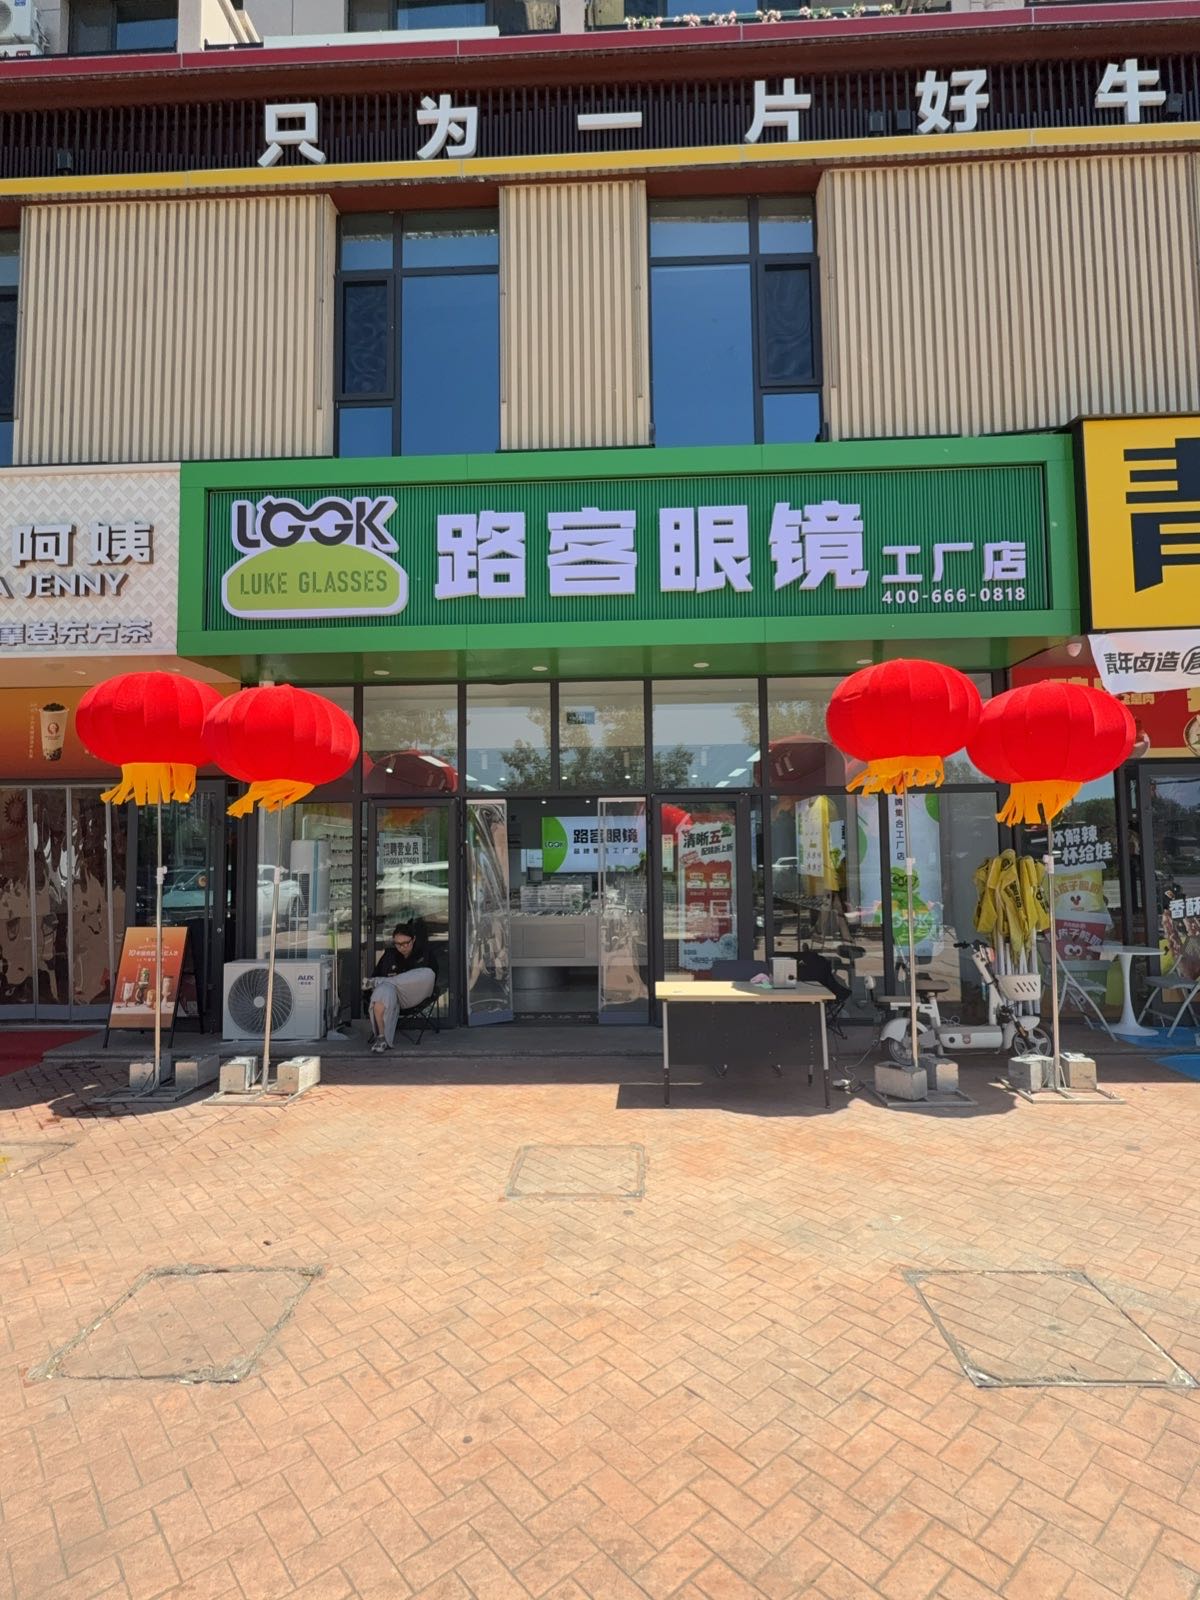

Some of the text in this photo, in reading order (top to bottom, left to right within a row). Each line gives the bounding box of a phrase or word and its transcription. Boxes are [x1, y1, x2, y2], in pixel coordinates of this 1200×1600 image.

[257, 58, 1166, 168] 只为一片好牛
[435, 501, 1026, 600] 路客眼镜 工厂店
[22, 571, 128, 598] JENNY
[240, 570, 388, 595] LUKE GLASSES
[881, 587, 1026, 604] 400-666-0818
[573, 828, 638, 844] 路客眼镜
